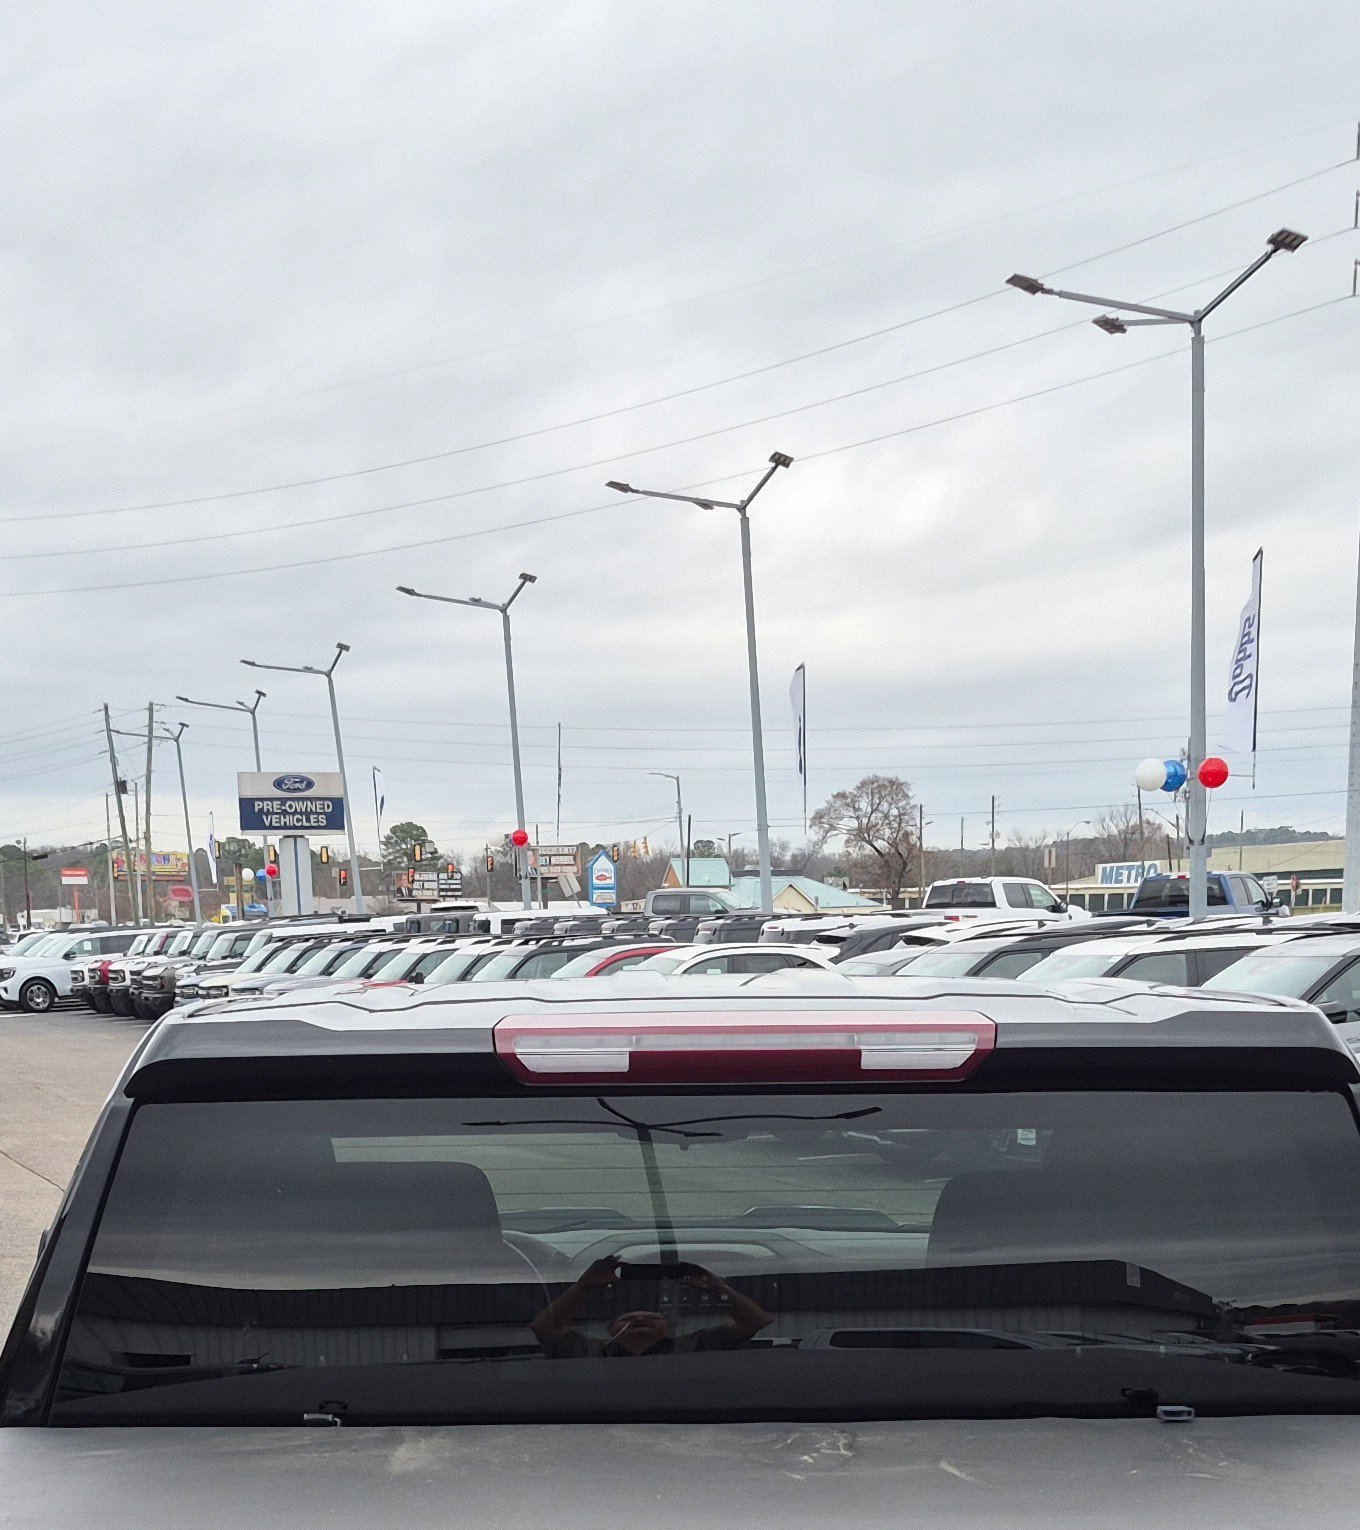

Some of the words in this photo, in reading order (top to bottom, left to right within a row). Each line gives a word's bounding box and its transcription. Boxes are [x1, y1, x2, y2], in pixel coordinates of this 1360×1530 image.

[254, 801, 333, 813] PRE-OWNED
[262, 814, 327, 827] VEHICLES
[1100, 862, 1158, 884] METRO
